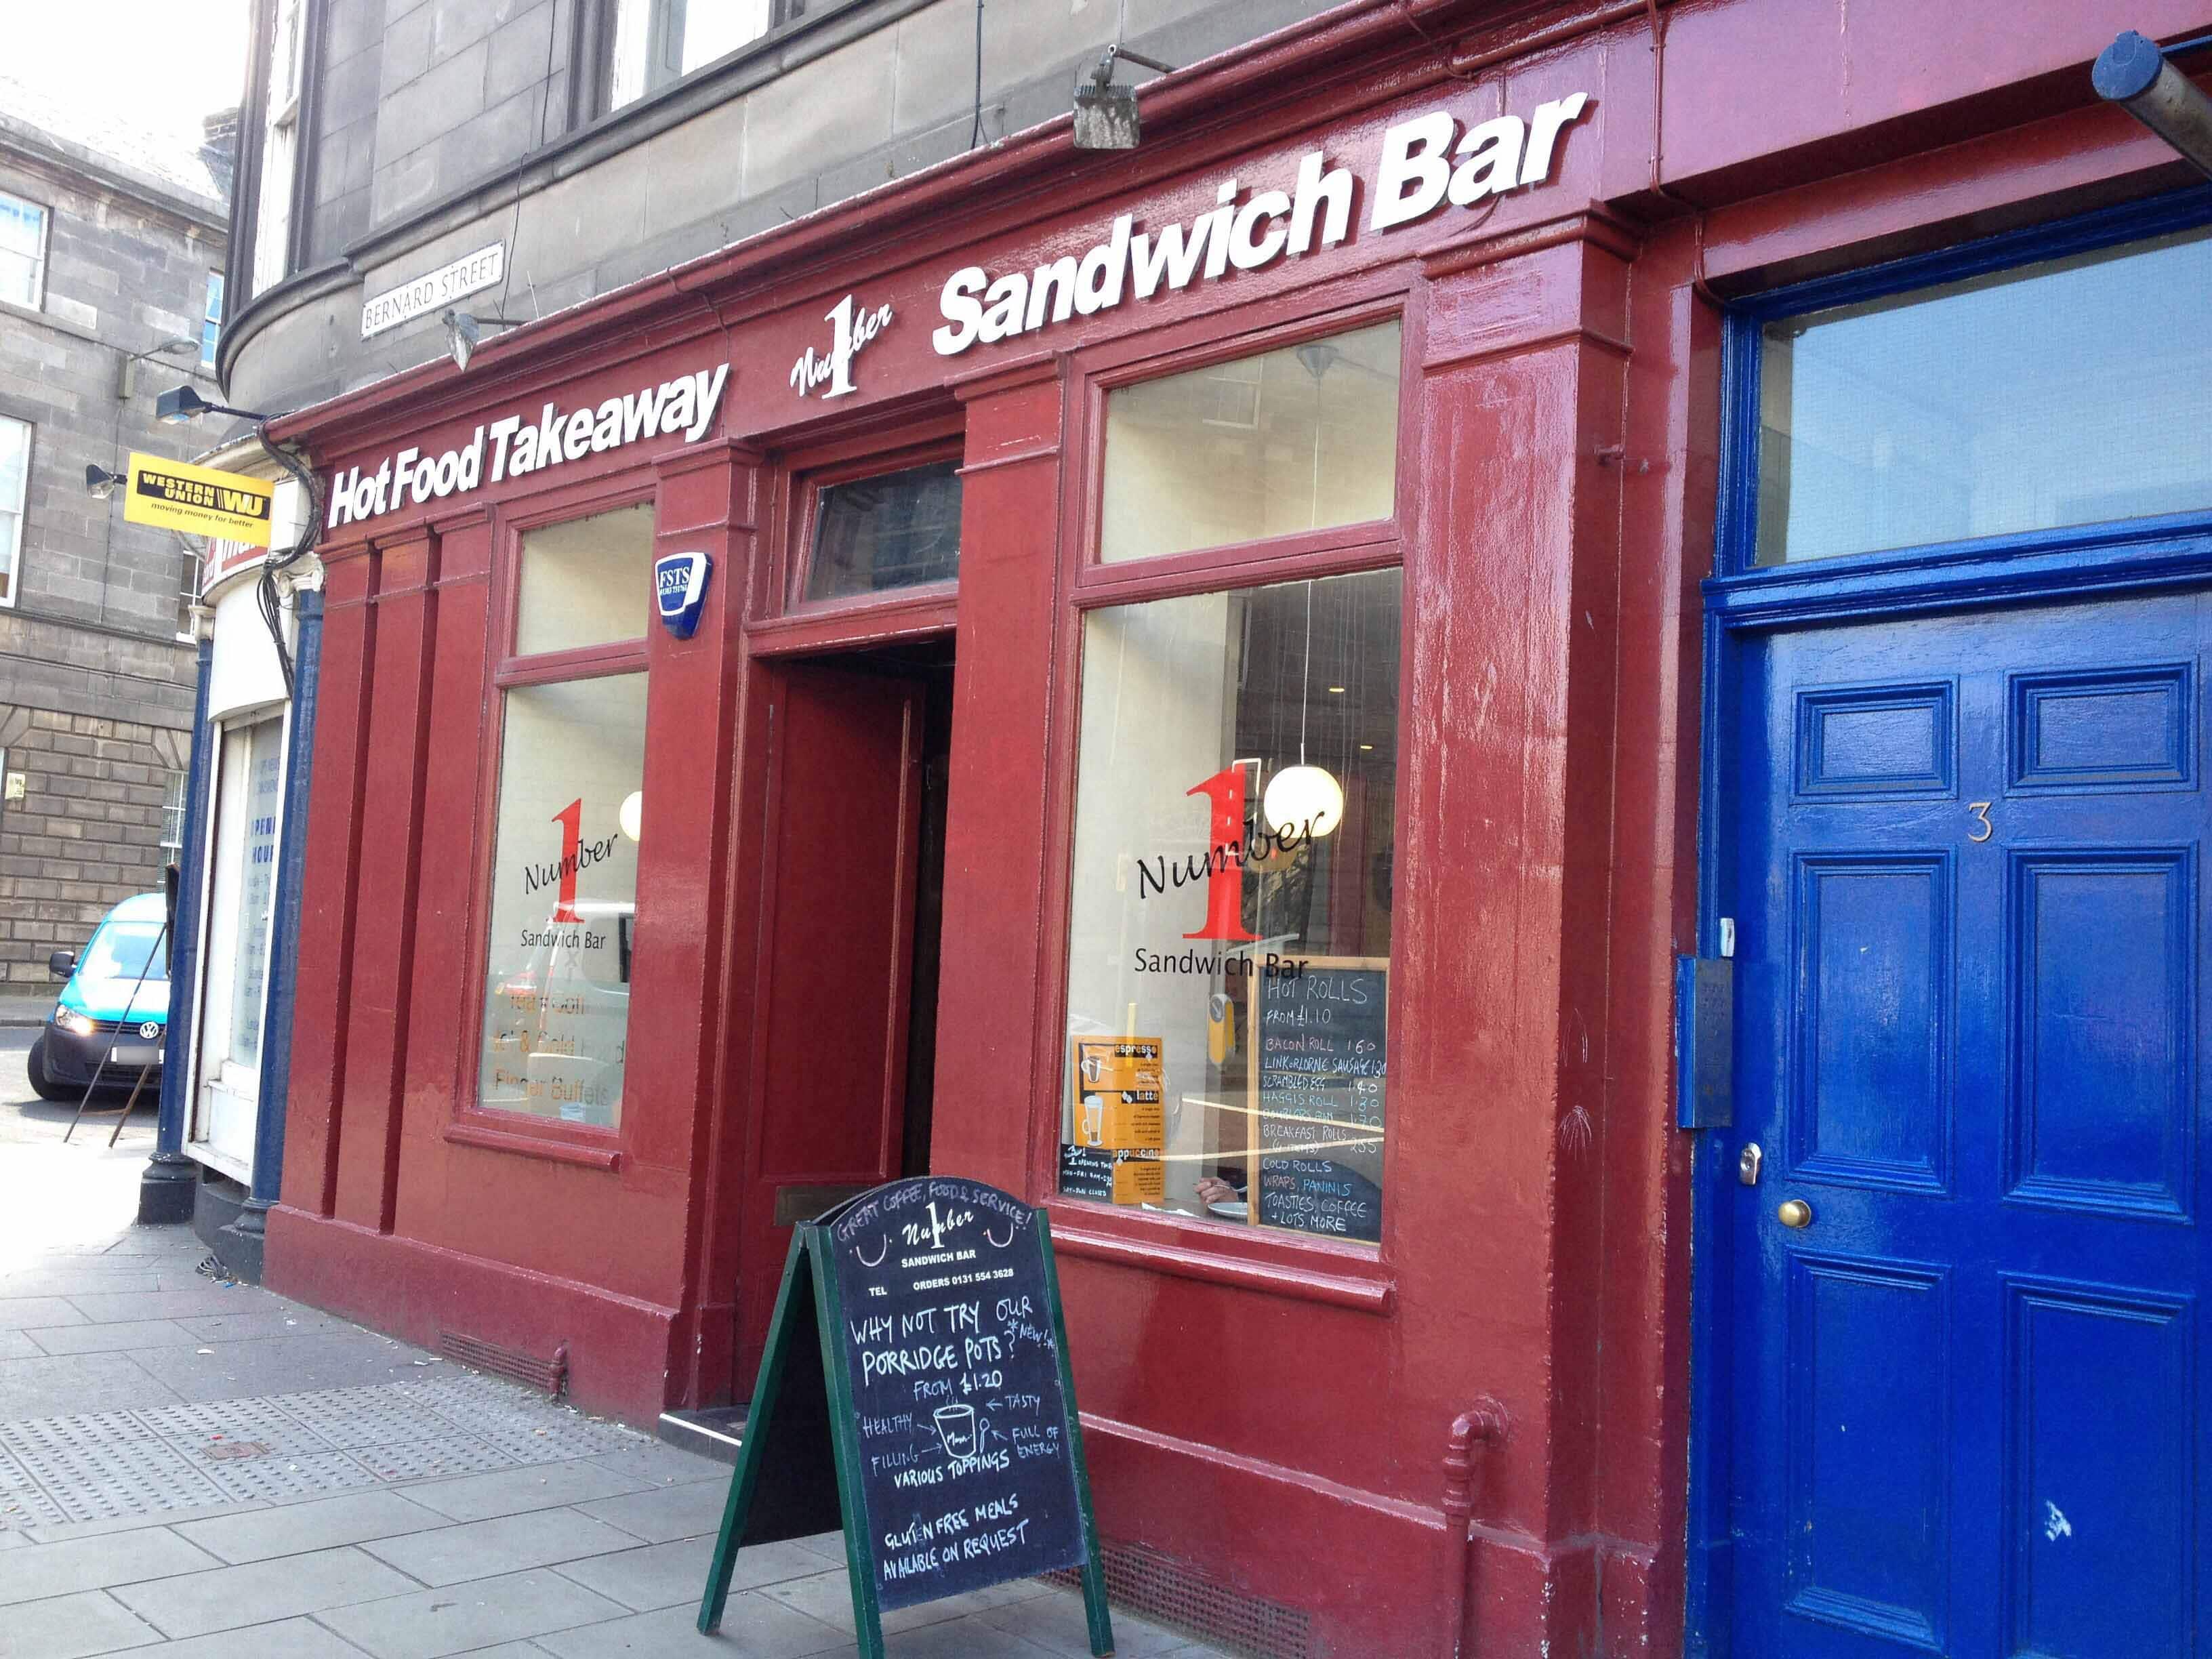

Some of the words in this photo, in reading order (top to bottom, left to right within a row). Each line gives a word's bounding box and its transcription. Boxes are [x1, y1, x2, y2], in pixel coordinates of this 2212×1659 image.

[932, 150, 1353, 355] Sandwich
[1369, 91, 1589, 232] Bar
[365, 282, 434, 329] BERNARD
[441, 253, 498, 298] STREET
[821, 293, 857, 400] 1
[327, 457, 392, 529] Hot
[390, 426, 484, 511] Food
[490, 363, 730, 483] Takeaway
[142, 473, 215, 497] WESTERN
[223, 489, 264, 516] WU
[165, 487, 214, 507] UNION
[151, 503, 183, 515] moving
[184, 510, 213, 521] money
[215, 514, 227, 523] for
[229, 518, 254, 529] better
[1967, 802, 1992, 842] 3
[525, 833, 618, 895] Number
[546, 798, 585, 923] 1
[1136, 811, 1325, 899] Number
[1183, 761, 1263, 941] 1
[520, 929, 580, 949] Sandwich
[585, 930, 607, 950] Bar
[1134, 948, 1254, 977] Sandwich
[1265, 952, 1309, 979] Bar
[1268, 977, 1300, 1000] HOT
[1307, 975, 1368, 1004] ROLLS
[1265, 1010, 1294, 1025] FROM
[1115, 1045, 1157, 1056] espresso
[1265, 1033, 1305, 1051] BACON
[1309, 1037, 1334, 1052] ROLL
[1265, 1055, 1290, 1069] LINK
[1332, 1057, 1370, 1076] SAUSAGE
[1136, 1090, 1158, 1101] latte
[1263, 1074, 1309, 1090] SCRAMBLED
[1309, 1078, 1326, 1092] EGG
[1263, 1091, 1305, 1105] HAGGIS
[1309, 1094, 1338, 1107] ROLL
[1263, 1124, 1315, 1139] BREAKFAST
[1322, 1126, 1347, 1141] ROLLS
[1112, 1149, 1160, 1160] appuccino
[1263, 1158, 1288, 1170] COLD
[1293, 1160, 1332, 1172] ROLLS
[1303, 1179, 1352, 1197] PANINIS
[837, 1200, 880, 1242] GREAT
[1322, 1199, 1367, 1218] COFFEE
[926, 1202, 945, 1249] 1
[1281, 1212, 1305, 1227] LOTS
[1311, 1216, 1346, 1232] MORE
[901, 1252, 954, 1268] SANDWICH
[956, 1250, 977, 1261] BAR
[868, 1286, 888, 1296] TEL
[913, 1276, 950, 1290] ORDERS
[951, 1273, 973, 1285] 0131
[975, 1271, 991, 1282] 554
[993, 1269, 1014, 1279] 3628
[850, 1315, 893, 1345] WHY
[903, 1308, 937, 1338] NOT
[943, 1300, 981, 1334] TRY
[996, 1295, 1033, 1321] OUR
[862, 1345, 958, 1389] PORRIDGE
[913, 1378, 953, 1401] FROM
[960, 1370, 1003, 1395] £1.20
[1005, 1393, 1041, 1416] TASTY
[863, 1413, 913, 1439] HEALTHY
[1012, 1425, 1040, 1444] FULL
[1046, 1426, 1060, 1441] OF
[872, 1443, 920, 1477] FILLING
[1017, 1442, 1061, 1459] ENERGY
[894, 1466, 944, 1489] VARIOUS
[947, 1449, 1011, 1480] TOPPINGS
[936, 1508, 970, 1536] FREE
[975, 1492, 1019, 1522] MEALS
[883, 1547, 939, 1581] AVAILABLE
[942, 1541, 960, 1563] ON
[963, 1518, 1029, 1559] REQUEST
